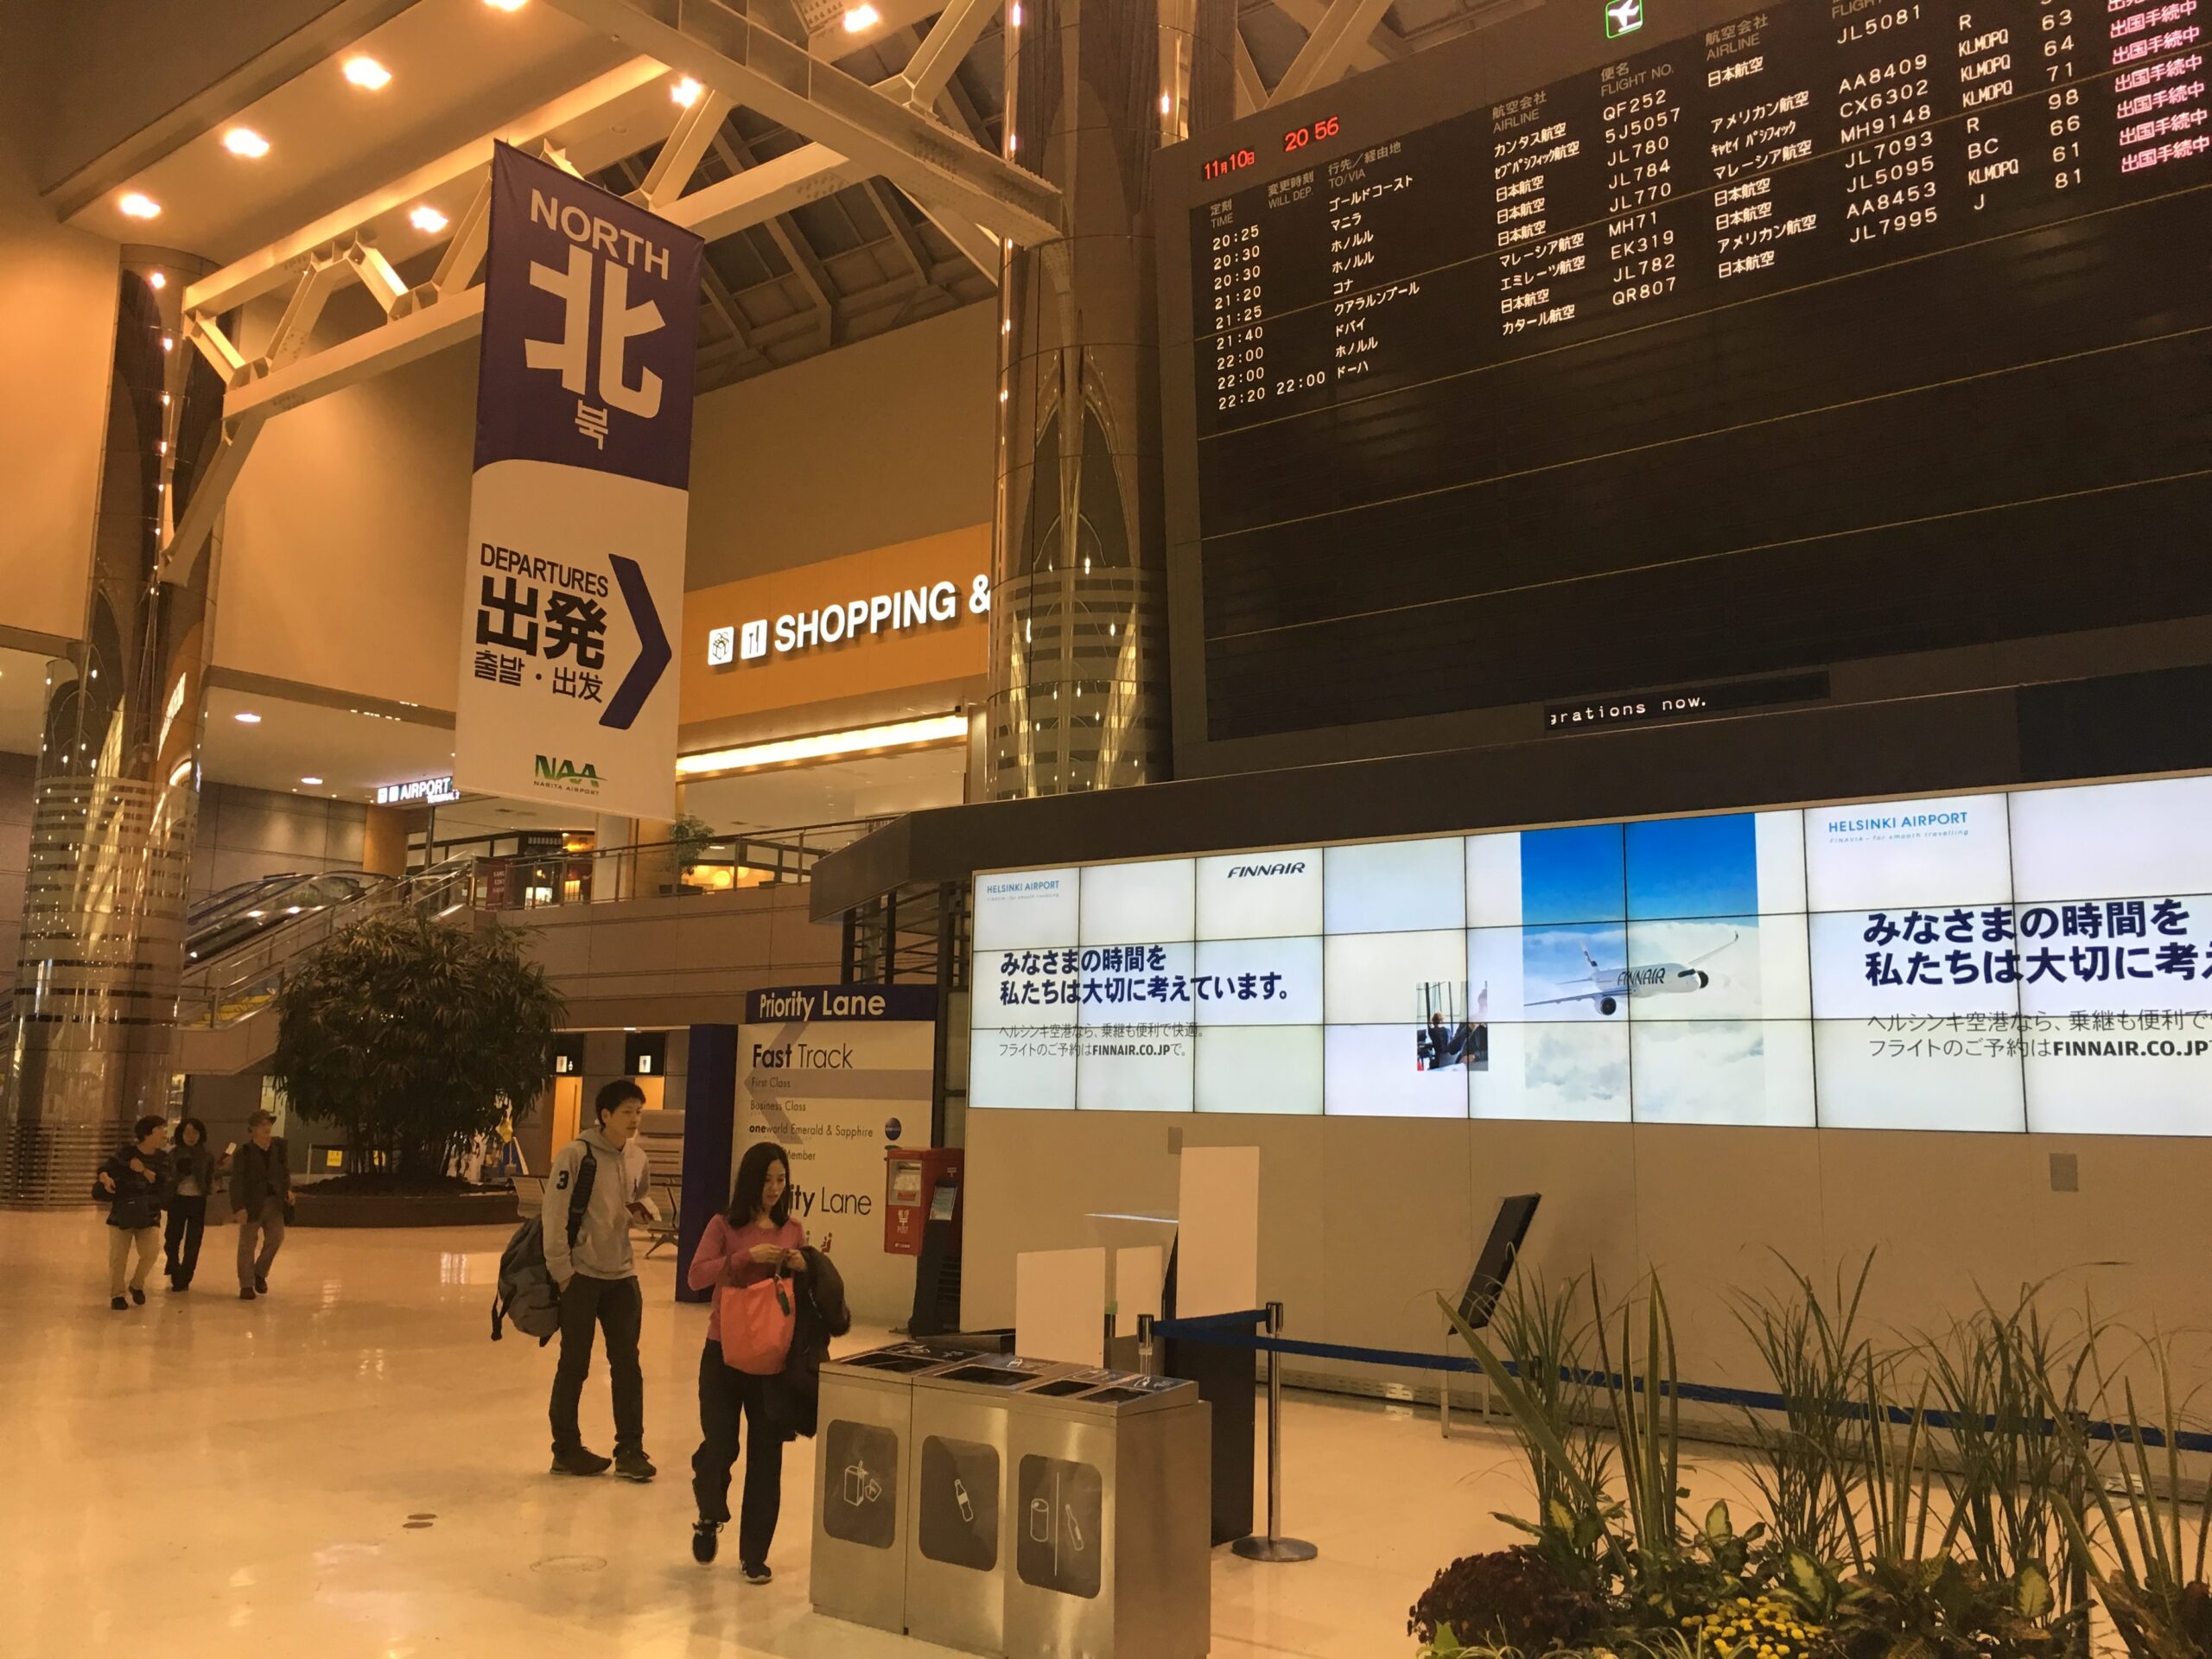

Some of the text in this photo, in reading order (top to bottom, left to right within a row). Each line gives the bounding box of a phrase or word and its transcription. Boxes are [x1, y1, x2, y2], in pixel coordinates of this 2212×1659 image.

[1706, 13, 1769, 47] 航空会社
[1707, 33, 1760, 60] AIRLINE
[1601, 62, 1630, 83] 便名
[1601, 64, 1674, 97] FLIGHT NO.
[1492, 91, 1548, 120] 航空会社
[1212, 4, 1919, 251] 20:25 ゴールドコースト カンタス航空 QF252 日本航空 JL5081
[1285, 116, 1339, 152] 20 56
[1493, 108, 1540, 134] AIRLINE
[1213, 245, 1260, 270] 20:30
[1331, 213, 1362, 232] マニラ
[1605, 107, 1681, 143] 5J5057
[1959, 14, 1972, 31] R
[1214, 9, 2072, 290] 20:30 ホノルル 日本航空 JL780 アメリカン航空 AA8409 KLMOPQ 63
[1215, 286, 1262, 310] 21:20
[1332, 251, 1375, 274] ホノルル
[1497, 197, 1545, 225] 日本航空
[1608, 159, 1670, 189] JL784
[1840, 79, 1929, 118] CX6302
[1961, 54, 2011, 82] KLMOPQ
[2044, 35, 2074, 57] 64
[2110, 0, 2197, 39] 出国手続中
[1216, 25, 2200, 330] 21:25 コナ 日本航空 JL770 マレーシア航空 MH9148 KLMOPQ 71 出国手続中
[1268, 171, 1313, 197] 変更時刻
[1328, 169, 1366, 189] TO/VIA
[1211, 199, 1232, 217] 定刻
[1217, 54, 2202, 350] 21:40 クアラルンプール マレーシア航空 MH71 日本航空 JL7093 R 98 出国手続中
[1268, 186, 1314, 210] WILL DEP.
[531, 188, 669, 281] NORTH
[1211, 213, 1233, 229] TIME
[1217, 80, 2204, 371] 22:00 ドバイ エミレーツ航空 EK319 日本航空 JL5095 BC 66 出国手続中
[1217, 108, 2208, 391] 22:00 ホノルル 日本航空 JL782 アメリカン航空 AA8453 KLMOPQ 61 出国手続中
[1218, 136, 2210, 410] 22:20 22:00 ドーハ カタール航空 QR807 日本航空 JL7995 J 81 出国手続中
[524, 244, 666, 419] 北
[575, 399, 609, 451] 북
[480, 543, 608, 598] DEPARTURES
[475, 575, 607, 671] 出発
[774, 574, 991, 652] SHOPPING &
[1662, 696, 1707, 711] now.
[535, 754, 607, 788] NAA
[400, 777, 451, 800] AIRPORT
[534, 781, 600, 796] NARITA AIRPORT
[1828, 811, 1967, 833] HELSINKI AIRPORT
[1228, 861, 1306, 879] FINNAIR
[987, 880, 1059, 893] HELSINKI AIRPORT
[1863, 899, 2190, 946] みなさまの時間を
[1000, 944, 1166, 976] みなさまの時間を
[1865, 941, 2212, 987] 私たちは大切に考
[1000, 971, 1288, 1006] 私たちは大切に考えています。
[1617, 967, 1665, 986] FINNAIR
[760, 990, 886, 1021] Priority Lane
[1867, 1008, 2212, 1033] ヘルシンキ空港なら、乗継も便利で
[753, 1043, 854, 1069] Fast Track
[1869, 1038, 2212, 1058] フライトのご予約はFINNAIR.CO.JP
[751, 1077, 791, 1088] First Class
[750, 1100, 806, 1112] Business Class
[749, 1122, 787, 1135] oneworld
[791, 1122, 823, 1135] Emerald
[826, 1125, 833, 1135] &
[835, 1125, 874, 1140] Sapphire
[556, 1170, 569, 1190] 3
[821, 1186, 872, 1215] Lane
